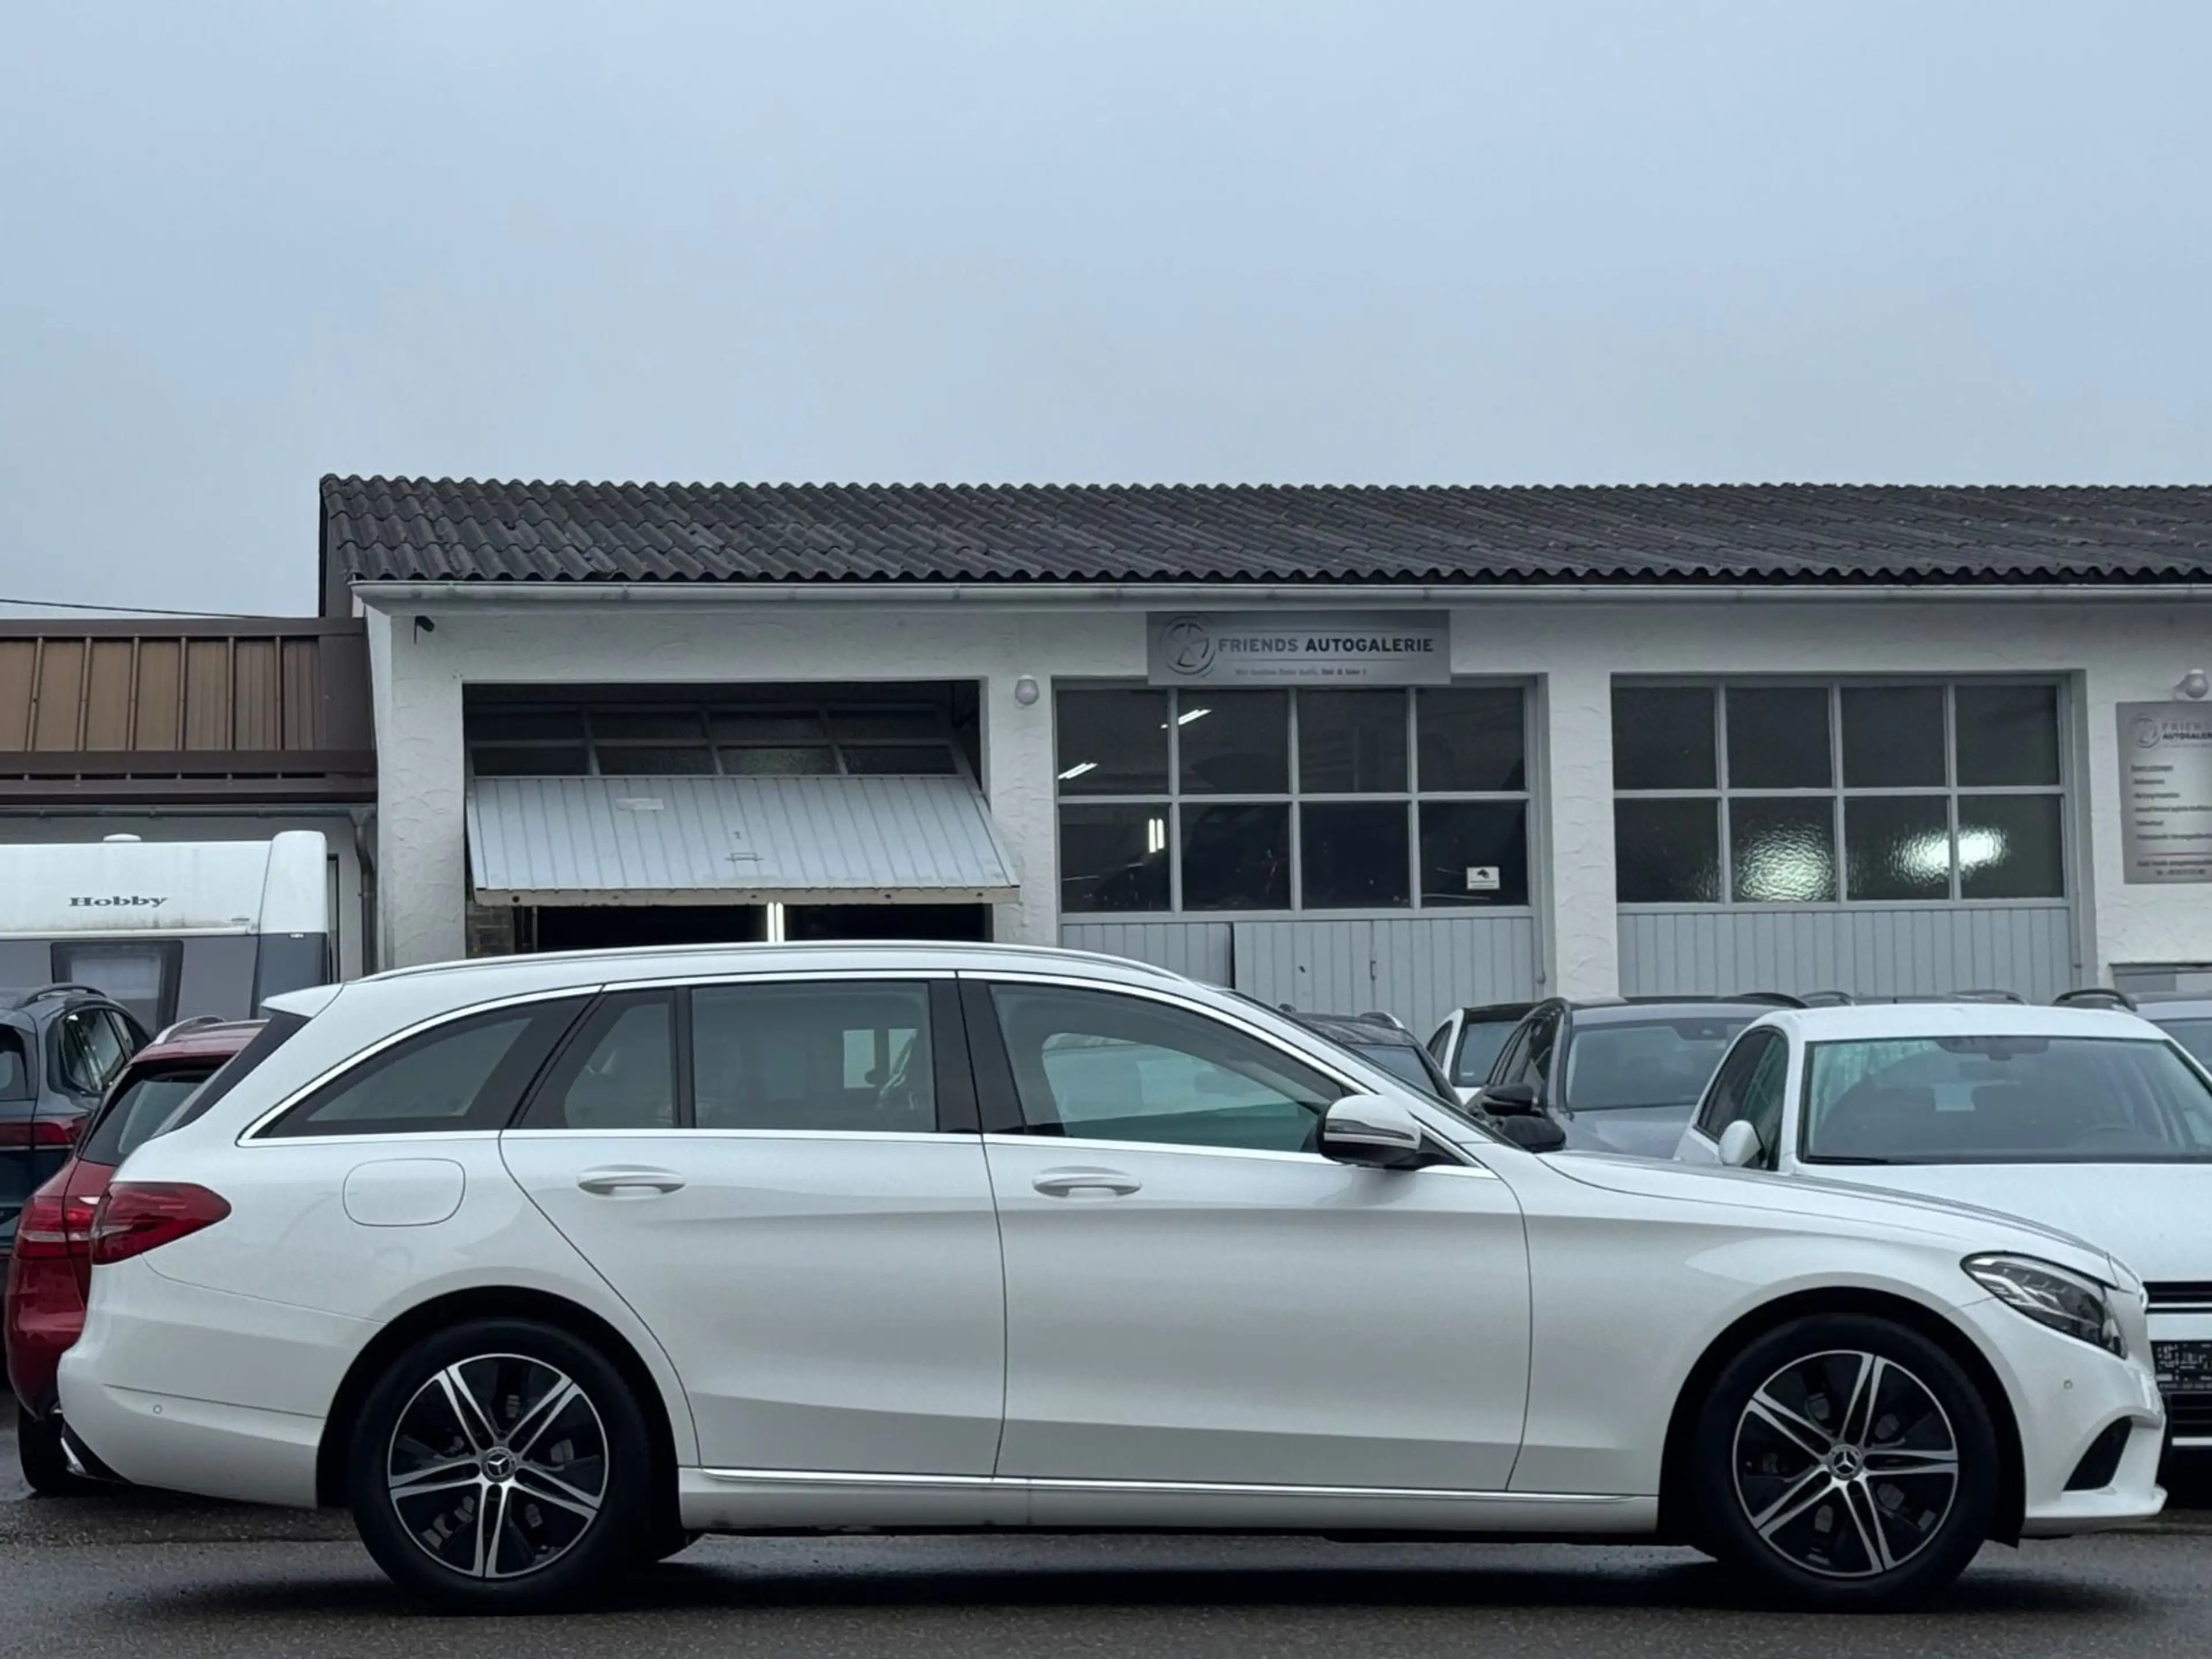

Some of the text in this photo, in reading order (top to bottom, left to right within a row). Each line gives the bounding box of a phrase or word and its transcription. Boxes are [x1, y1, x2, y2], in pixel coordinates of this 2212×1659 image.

[1218, 638, 1434, 653] FRIENDS AUTOGALERIE
[69, 895, 168, 908] Hobby
